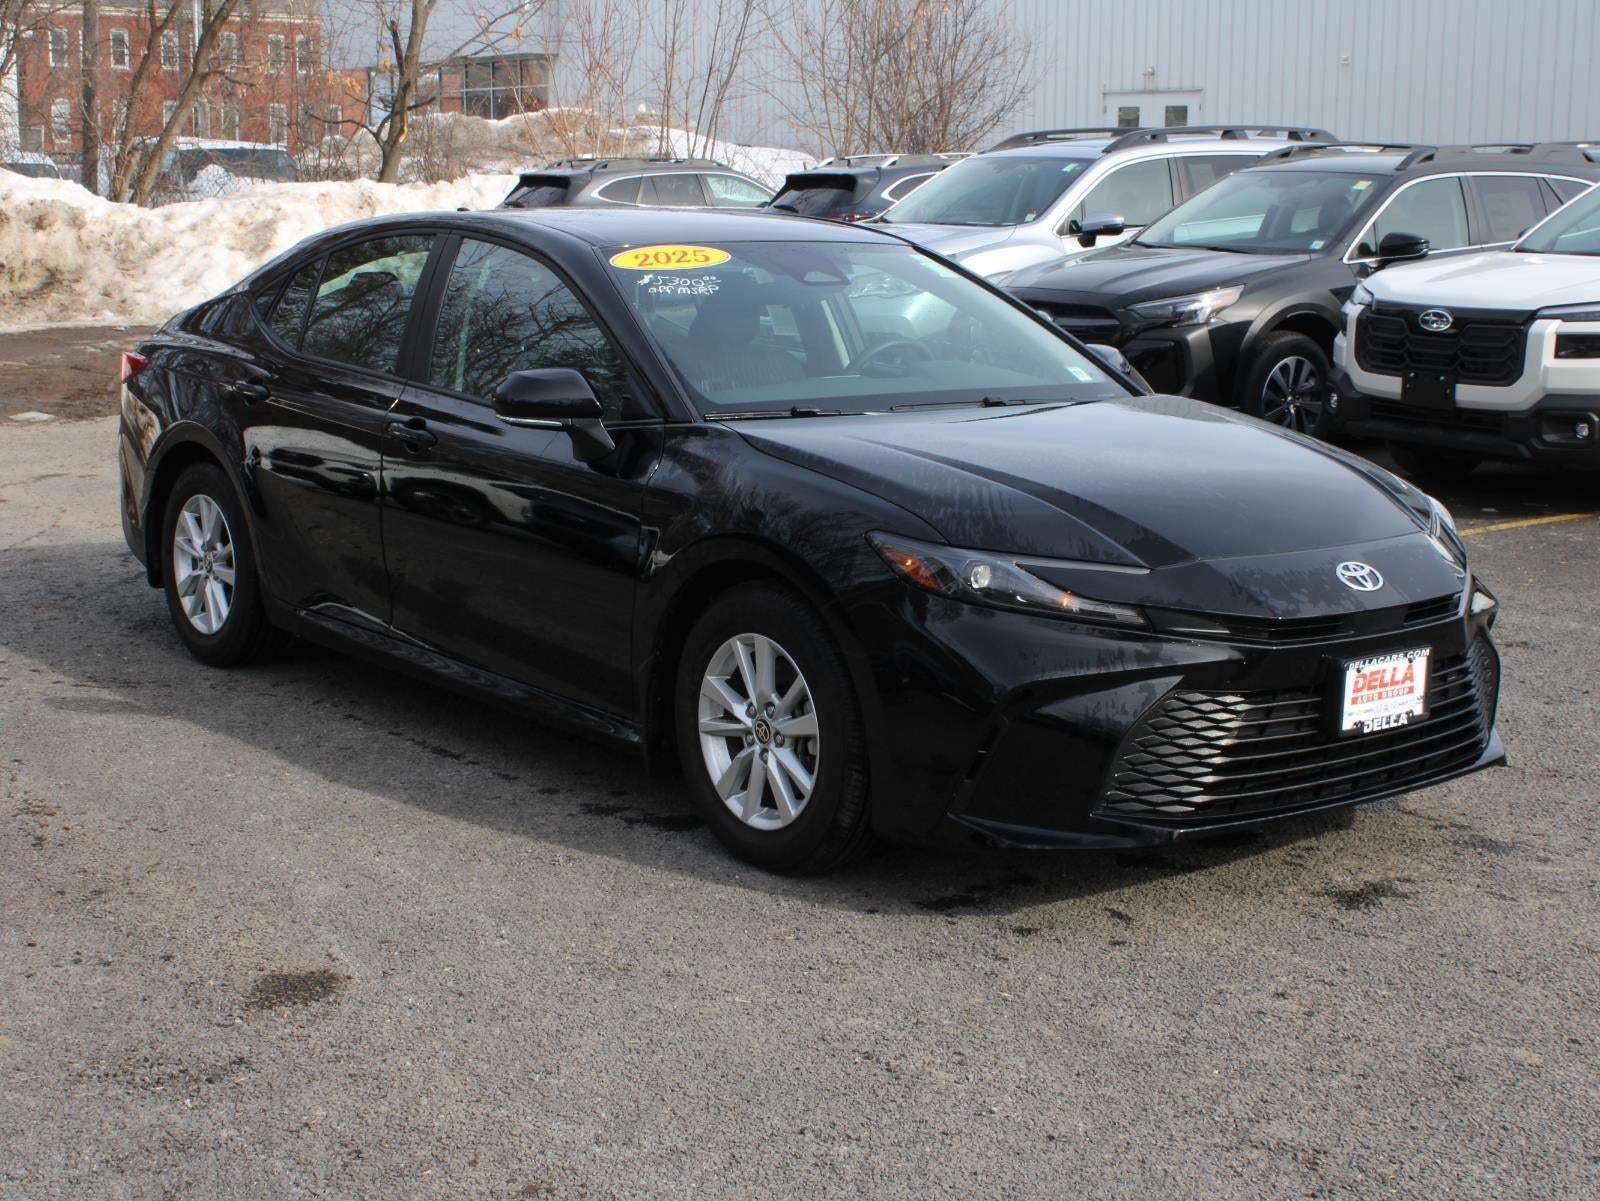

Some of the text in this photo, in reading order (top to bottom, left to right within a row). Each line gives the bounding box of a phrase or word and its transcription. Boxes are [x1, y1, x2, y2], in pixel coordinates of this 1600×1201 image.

[634, 250, 710, 267] 2025
[1352, 664, 1414, 693] DELLA
[1357, 687, 1409, 704] AUTO GROUP
[1363, 713, 1408, 733] DELLA
